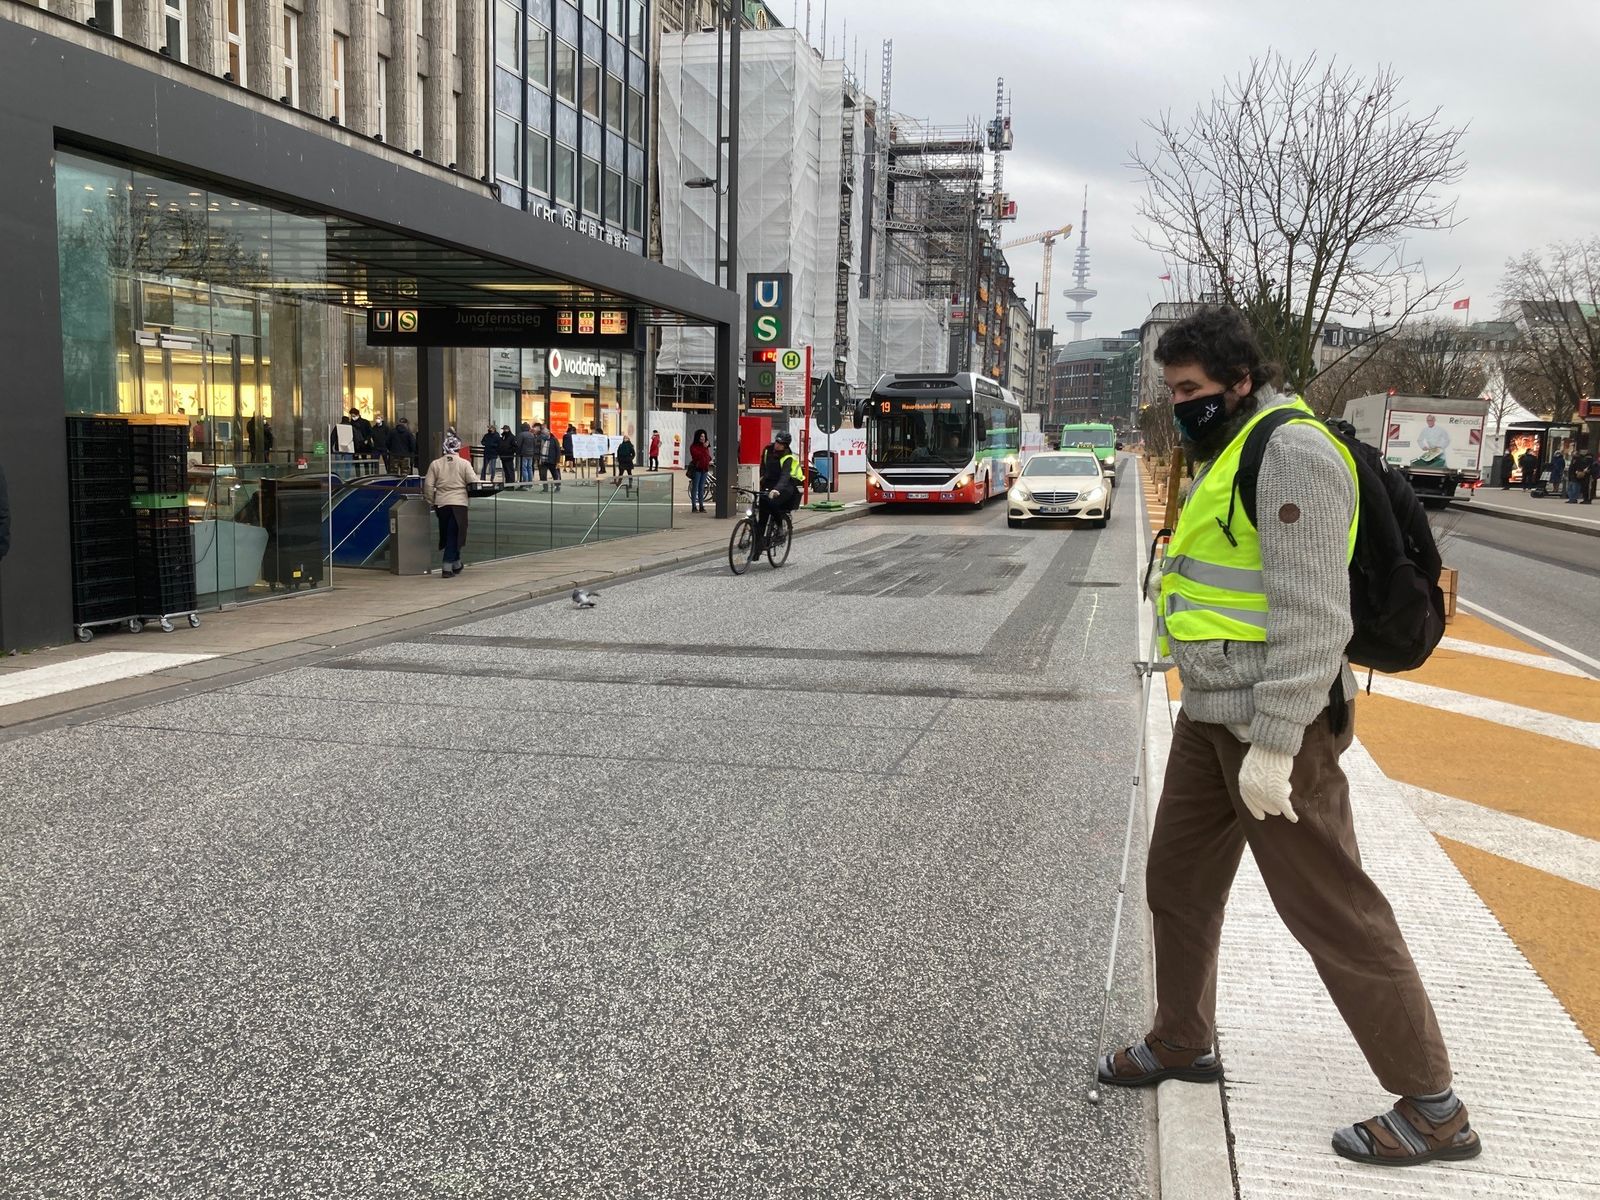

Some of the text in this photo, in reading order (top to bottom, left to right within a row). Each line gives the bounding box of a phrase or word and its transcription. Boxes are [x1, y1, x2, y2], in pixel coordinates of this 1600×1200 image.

[757, 280, 778, 308] U
[376, 312, 389, 329] U
[455, 311, 541, 327] Jungfernstieg
[757, 315, 777, 342] S
[563, 356, 606, 377] vodafone
[880, 402, 890, 413] 19
